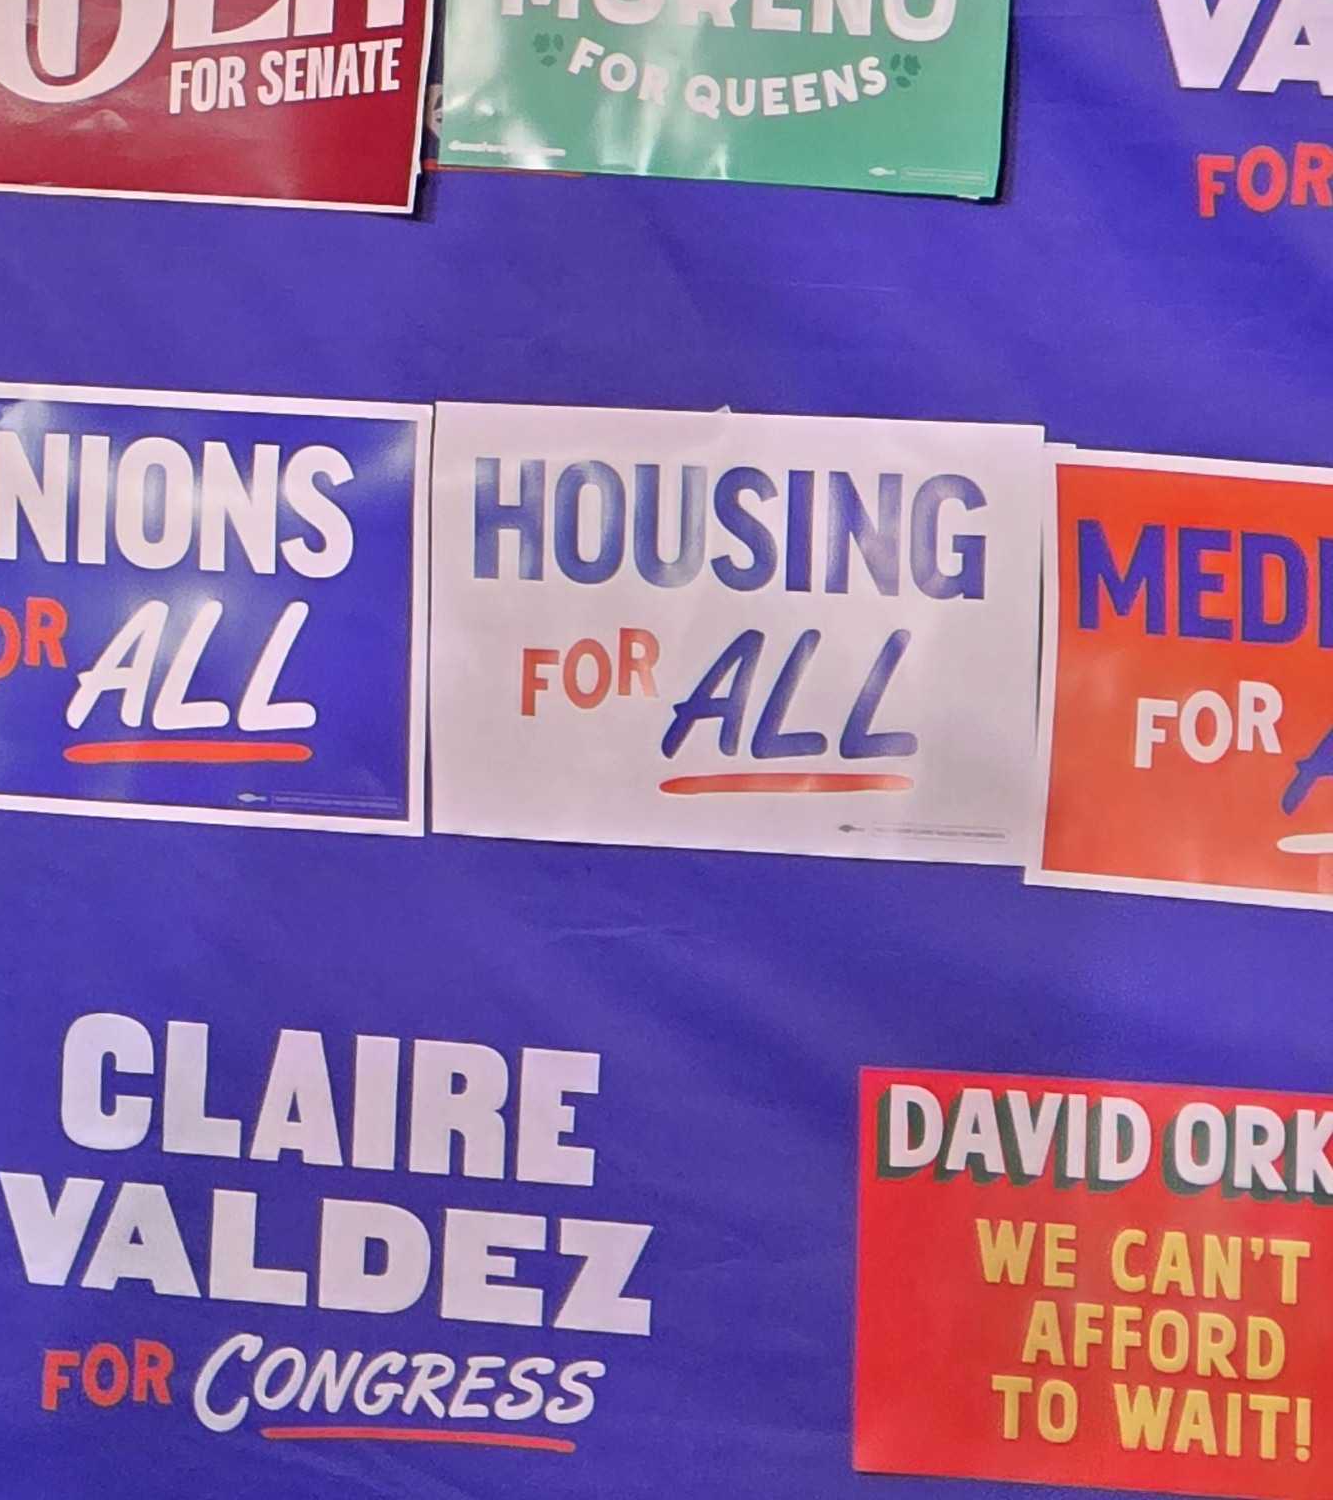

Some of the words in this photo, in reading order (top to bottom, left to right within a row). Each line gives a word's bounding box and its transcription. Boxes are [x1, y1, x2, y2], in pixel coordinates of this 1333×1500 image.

[169, 58, 246, 113] FOR
[257, 38, 403, 105] SENATE
[568, 37, 669, 107] FOR
[685, 57, 889, 122] QUEENS
[1198, 141, 1333, 219] FOR
[473, 457, 988, 600] HOUSING
[65, 600, 317, 731] ALL
[521, 626, 660, 716] FOR
[660, 628, 918, 760] ALL
[1134, 680, 1283, 769] FOR
[60, 1012, 601, 1186] CLAIRE
[883, 1083, 1151, 1188] DAVID
[1169, 1102, 1333, 1199] ORK
[975, 1218, 1077, 1288] WE
[1111, 1229, 1311, 1305] CAN'T
[40, 1340, 174, 1412] FOR
[193, 1332, 606, 1433] CONGRESS
[1022, 1300, 1285, 1380] AFFORD
[992, 1374, 1078, 1444] TO
[1114, 1383, 1312, 1463] WAIT!
